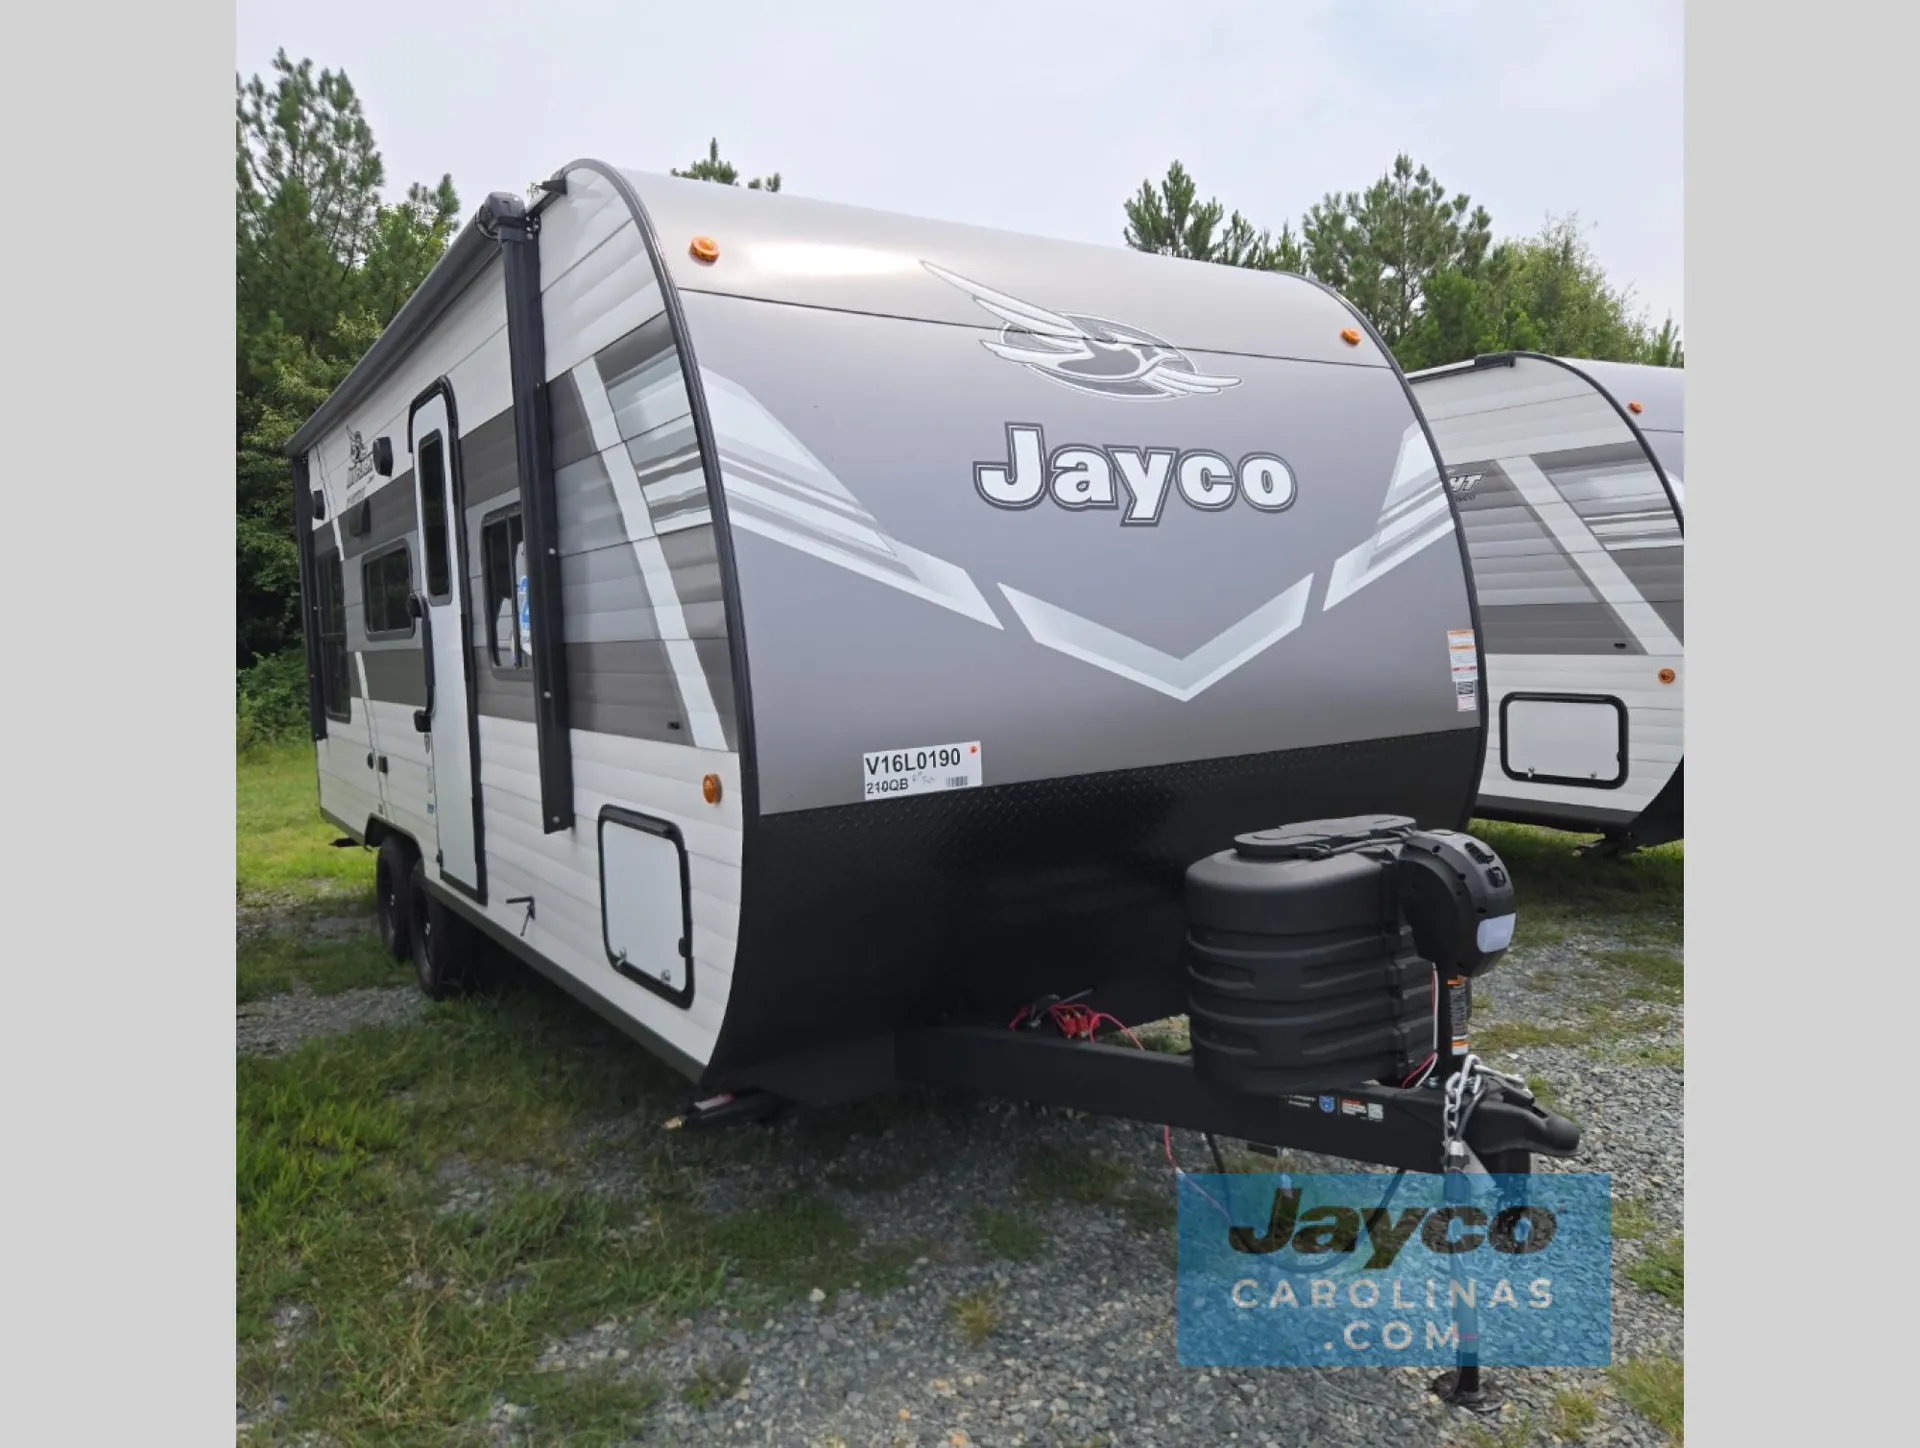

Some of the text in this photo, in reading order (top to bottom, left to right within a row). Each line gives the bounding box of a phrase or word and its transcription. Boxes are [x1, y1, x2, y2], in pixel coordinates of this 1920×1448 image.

[974, 423, 1297, 526] Jayco
[865, 748, 960, 775] V16L0190
[867, 778, 908, 794] 210QB
